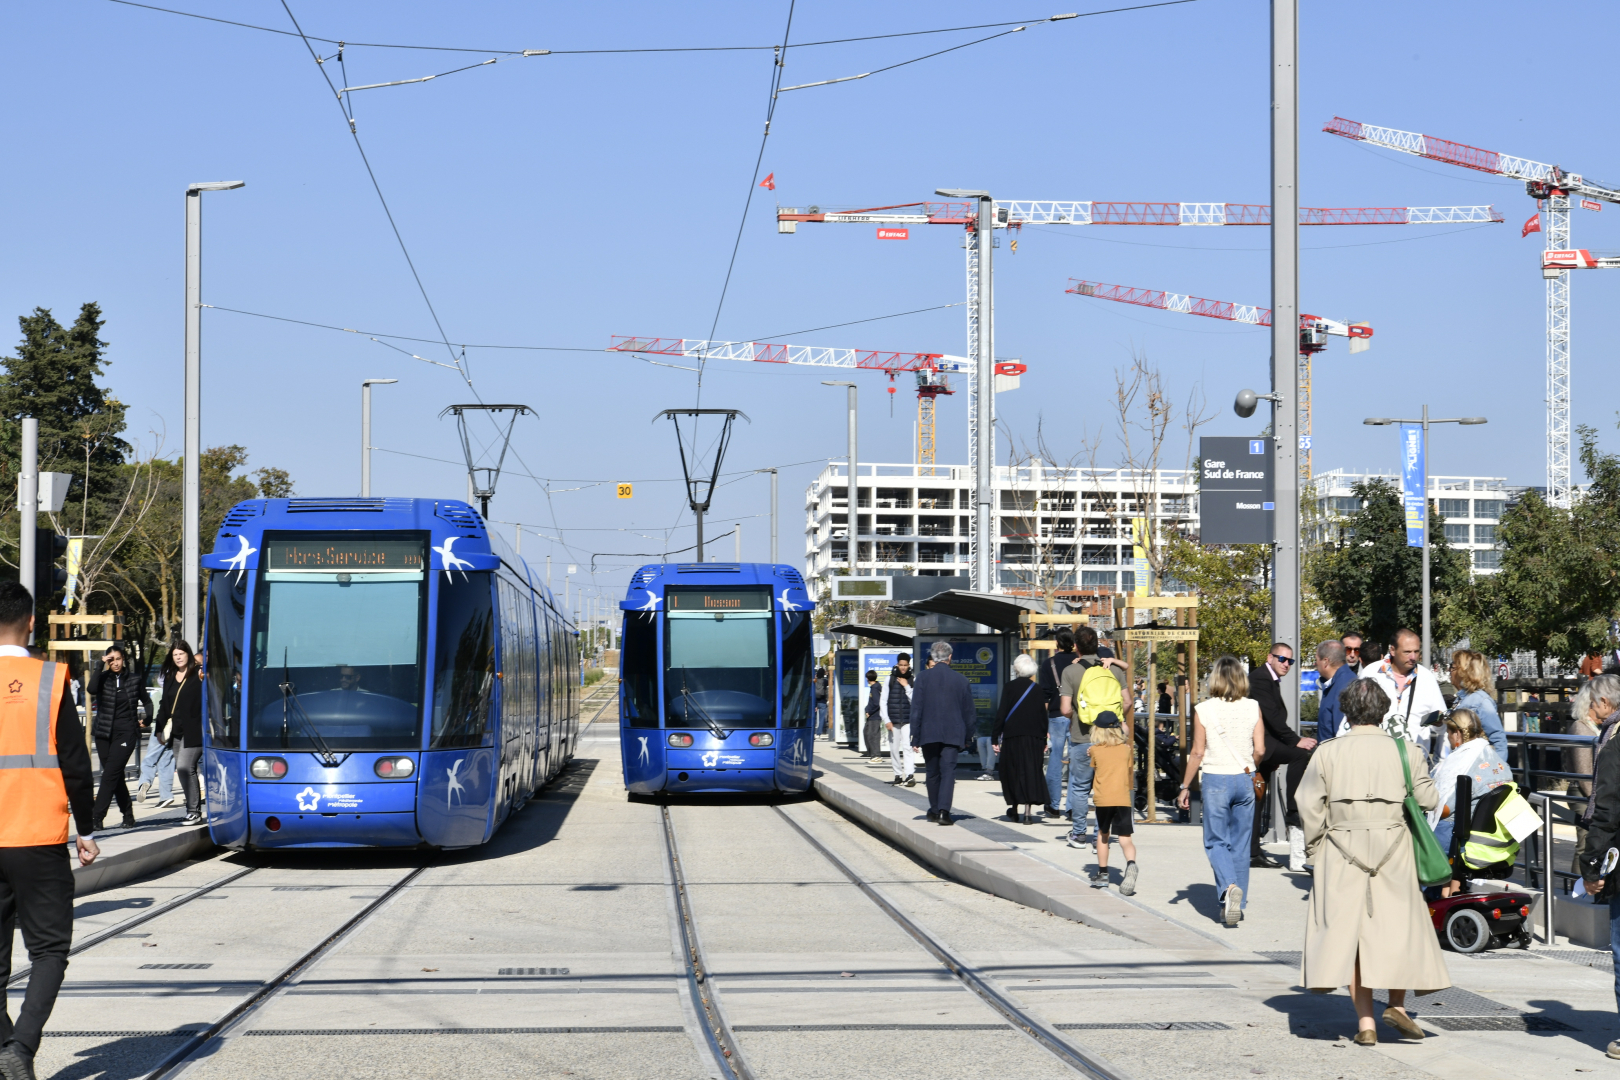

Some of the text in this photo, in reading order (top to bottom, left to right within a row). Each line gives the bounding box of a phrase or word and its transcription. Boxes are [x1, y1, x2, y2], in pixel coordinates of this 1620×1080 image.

[1253, 442, 1259, 453] 1
[1204, 459, 1226, 469] Gare
[1204, 469, 1264, 479] Sud de France
[618, 486, 631, 496] 30
